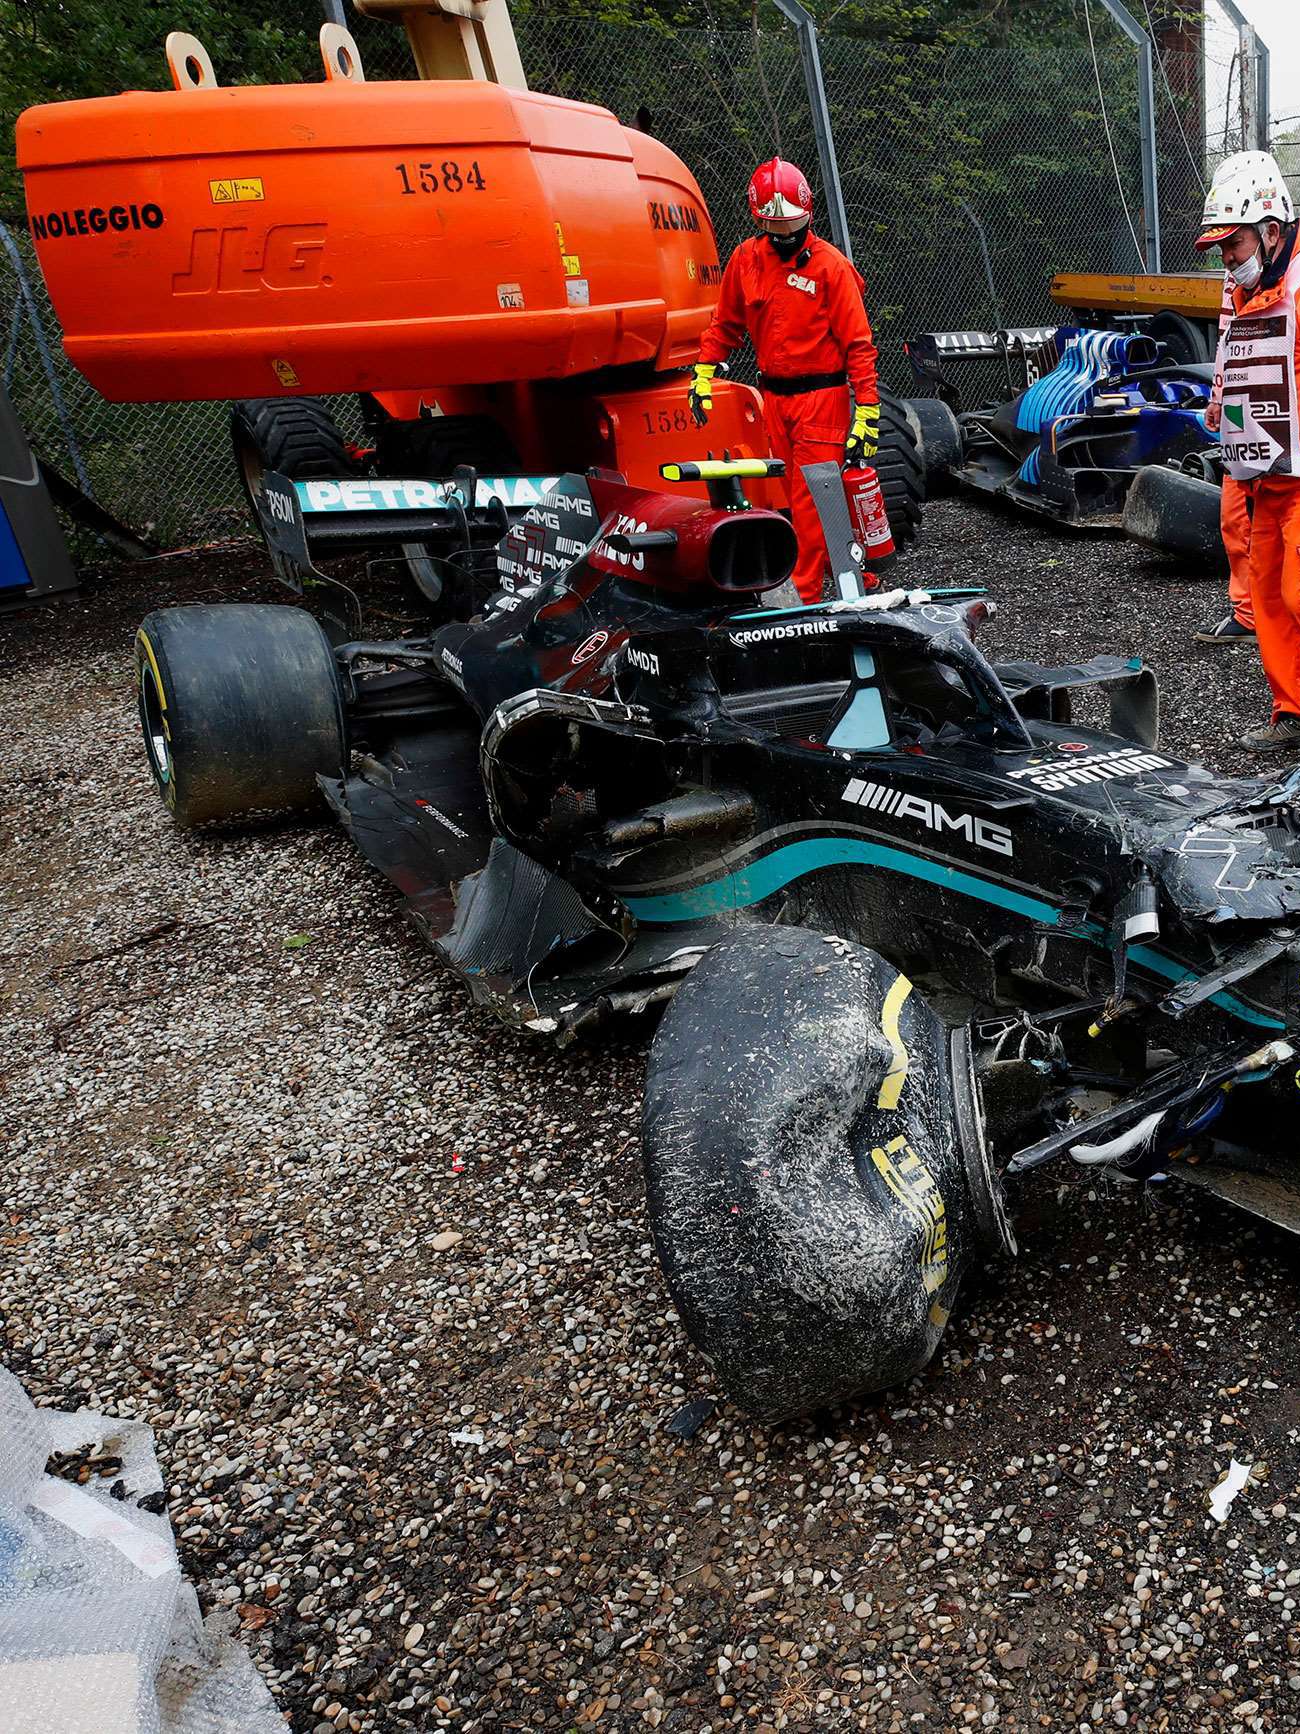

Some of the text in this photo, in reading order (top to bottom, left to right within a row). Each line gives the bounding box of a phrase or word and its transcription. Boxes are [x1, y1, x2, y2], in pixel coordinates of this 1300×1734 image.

[395, 161, 486, 194] 1584
[32, 203, 163, 241] NOLEGGIO
[786, 273, 817, 295] CEA
[735, 620, 839, 643] CROWDSTRIKE
[628, 647, 652, 673] AMD
[1006, 748, 1142, 779] PETRONAS
[1030, 754, 1174, 791] SYNTIUM
[894, 793, 1013, 857] AMG
